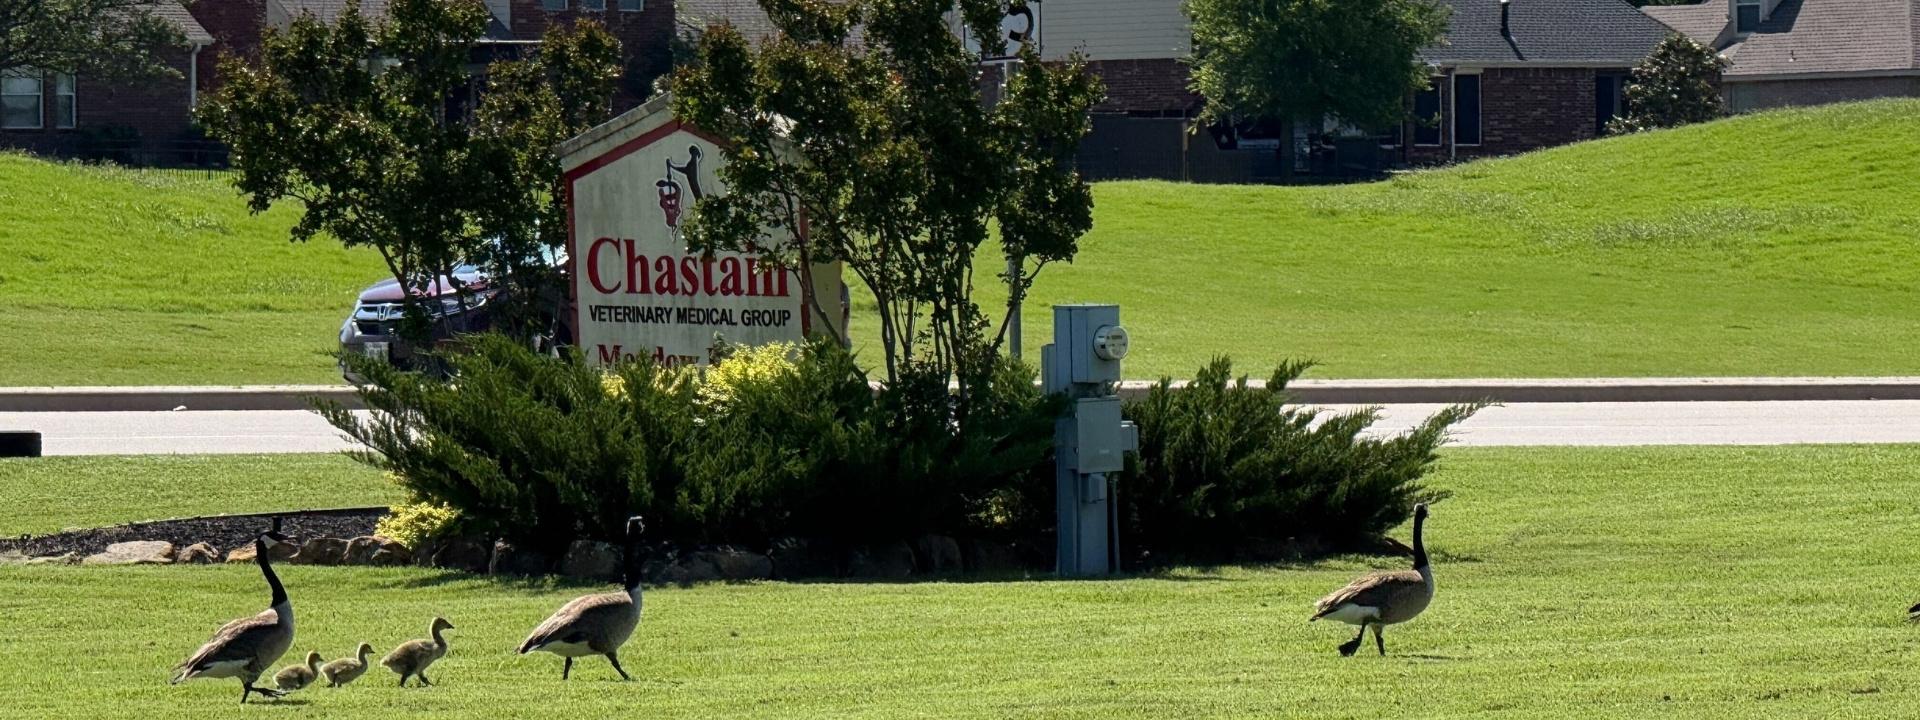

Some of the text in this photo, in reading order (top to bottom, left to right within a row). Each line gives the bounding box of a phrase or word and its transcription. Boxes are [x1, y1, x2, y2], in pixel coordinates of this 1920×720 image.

[587, 237, 790, 297] Chastain
[589, 305, 791, 328] VETERINARY MEDICAL GROUP
